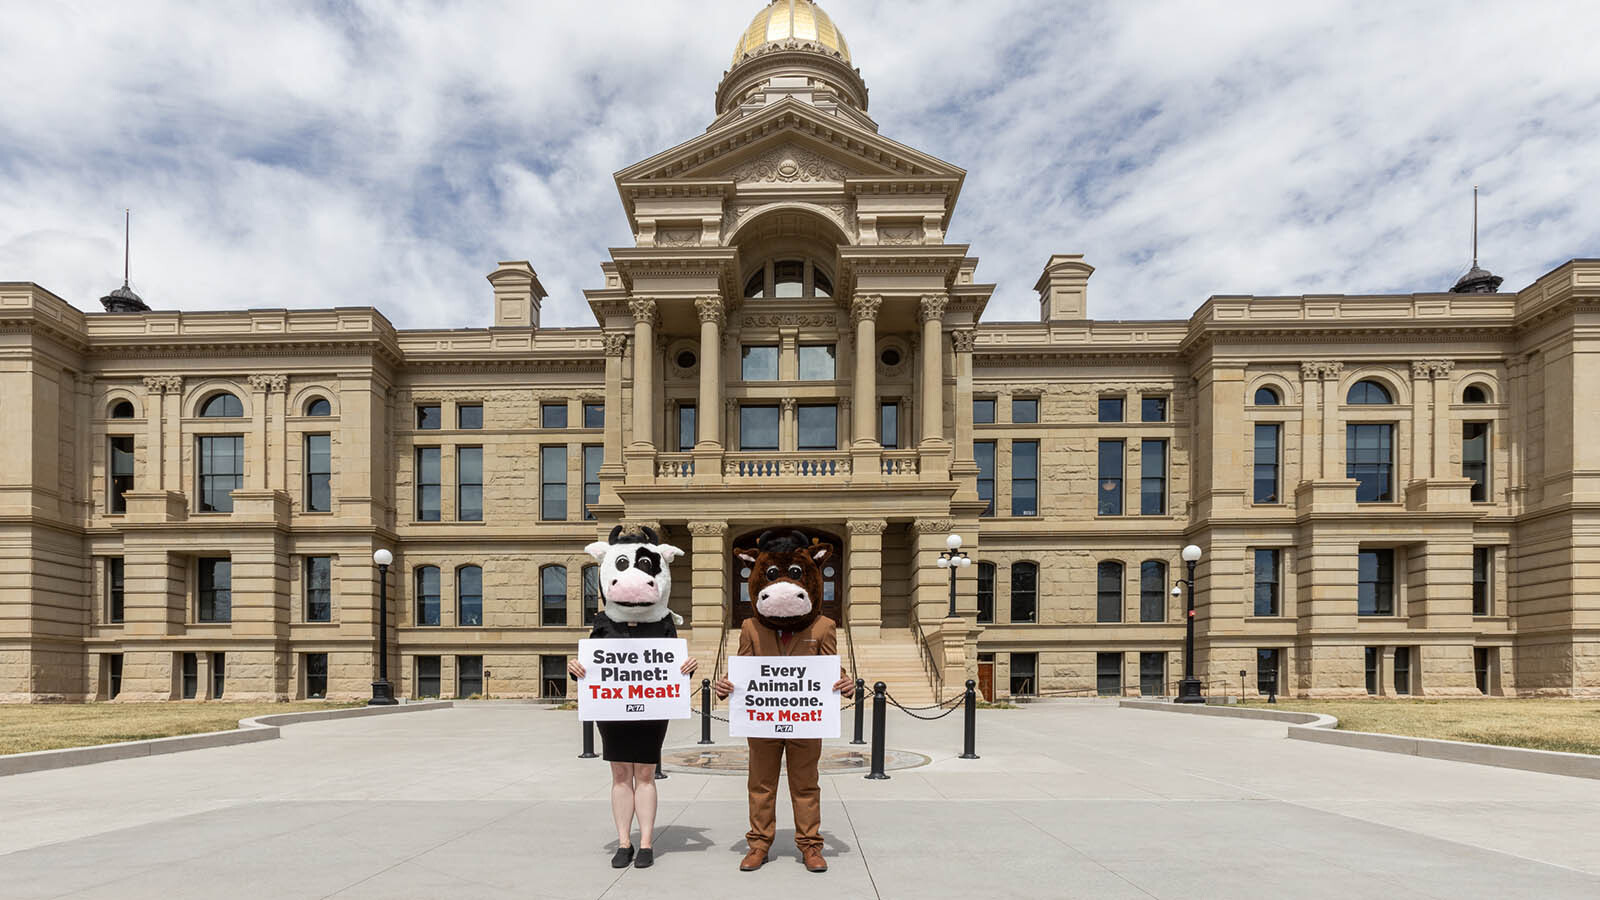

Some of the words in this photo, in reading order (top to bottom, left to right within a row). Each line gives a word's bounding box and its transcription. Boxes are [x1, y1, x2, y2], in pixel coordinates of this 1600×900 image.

[593, 650, 638, 664] Save
[643, 649, 675, 663] the
[601, 667, 668, 681] Planet:
[761, 665, 806, 679] Every
[589, 685, 623, 699] Tax
[628, 684, 680, 698] Meat!
[747, 680, 803, 692] Animal
[808, 680, 821, 692] Is
[745, 695, 824, 707] Someone.
[746, 709, 774, 722] Tax
[779, 710, 822, 722] Meat!
